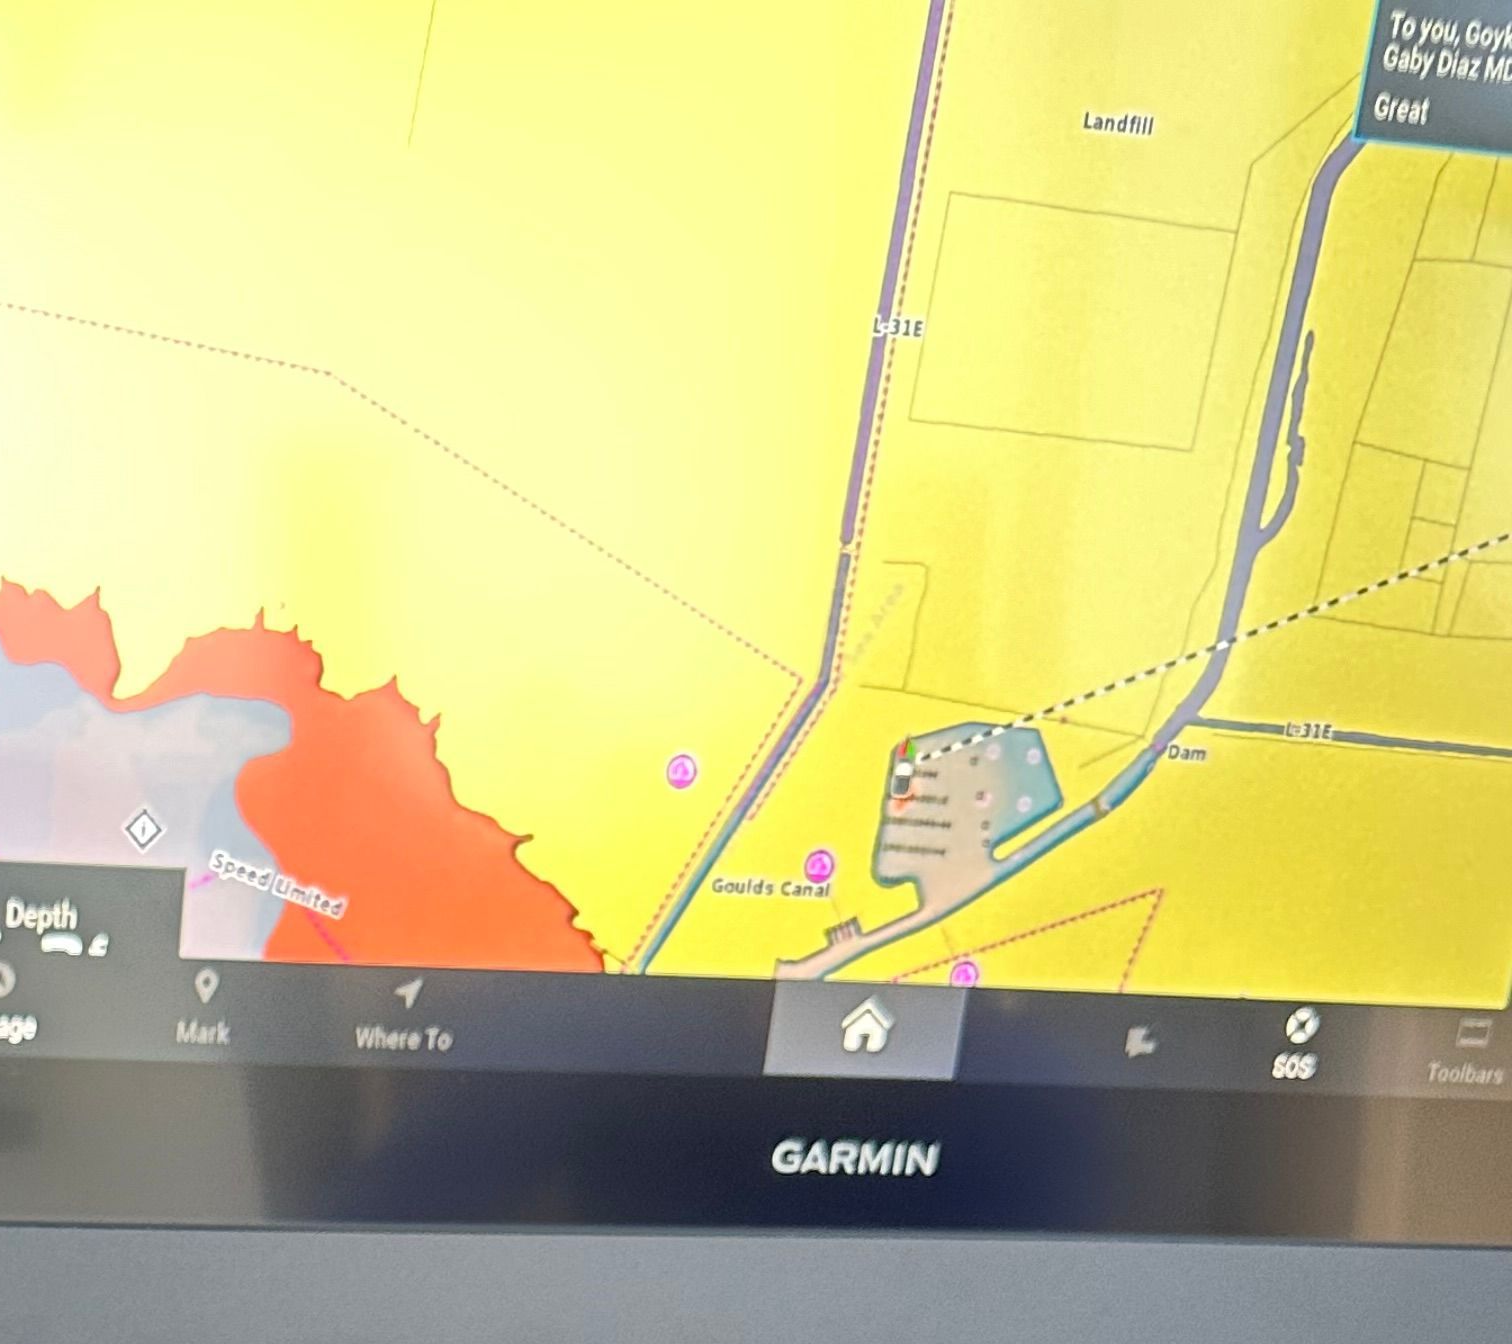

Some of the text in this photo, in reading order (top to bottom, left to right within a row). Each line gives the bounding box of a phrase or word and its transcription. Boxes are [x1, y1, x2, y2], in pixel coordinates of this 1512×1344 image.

[1390, 9, 1416, 41] To
[1383, 42, 1436, 80] Gaby
[1437, 48, 1482, 82] Diaz
[1374, 92, 1430, 126] Great
[1082, 111, 1155, 136] Landfill
[872, 317, 924, 338] L-31E
[1168, 746, 1206, 765] Dam
[211, 852, 272, 890] Speed
[711, 877, 831, 898] Goulds Canal
[5, 896, 78, 935] Depth
[177, 1018, 231, 1046] Mark
[356, 1024, 453, 1052] Where To
[1272, 1052, 1318, 1080] SOS
[1428, 1062, 1504, 1086] Toolbars
[771, 1138, 941, 1178] GARMIN
